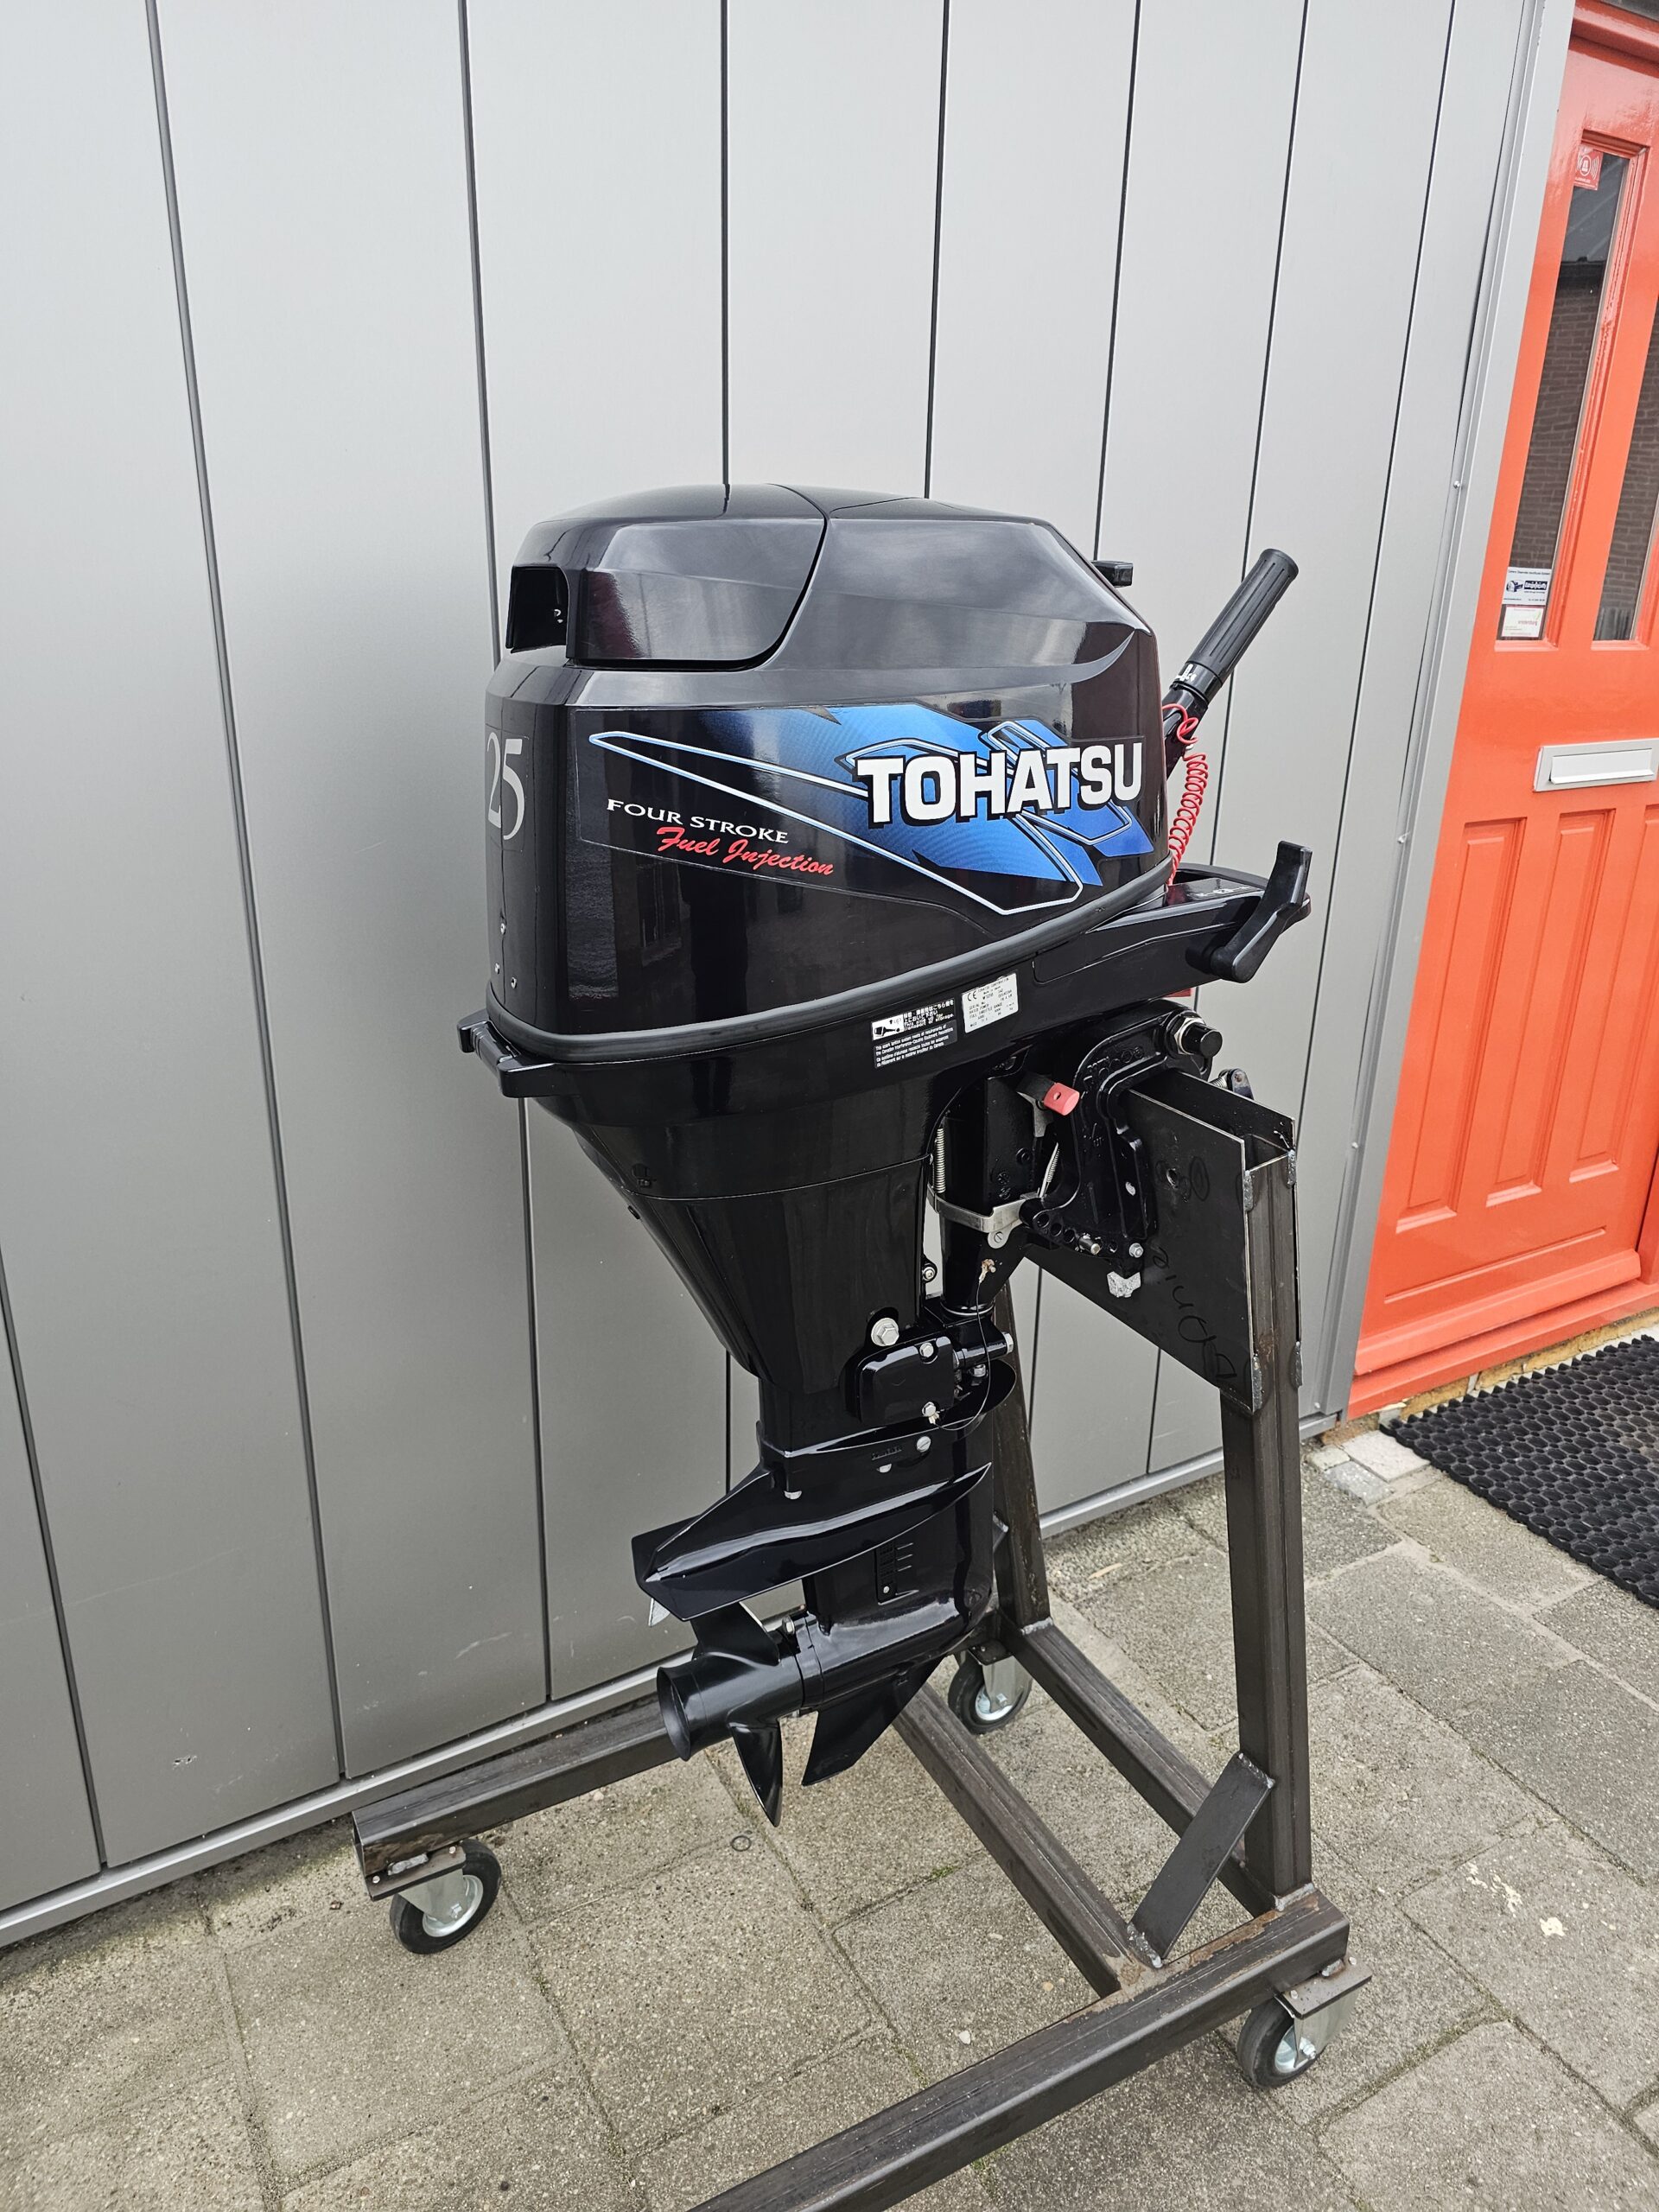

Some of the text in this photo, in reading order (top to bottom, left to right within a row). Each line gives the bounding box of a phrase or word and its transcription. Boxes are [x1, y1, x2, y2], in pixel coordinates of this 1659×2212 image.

[486, 732, 525, 841] 25
[856, 742, 1142, 825] TOHATSU
[606, 798, 790, 844] FOUR STROKE
[656, 826, 834, 875] Fuel Injection
